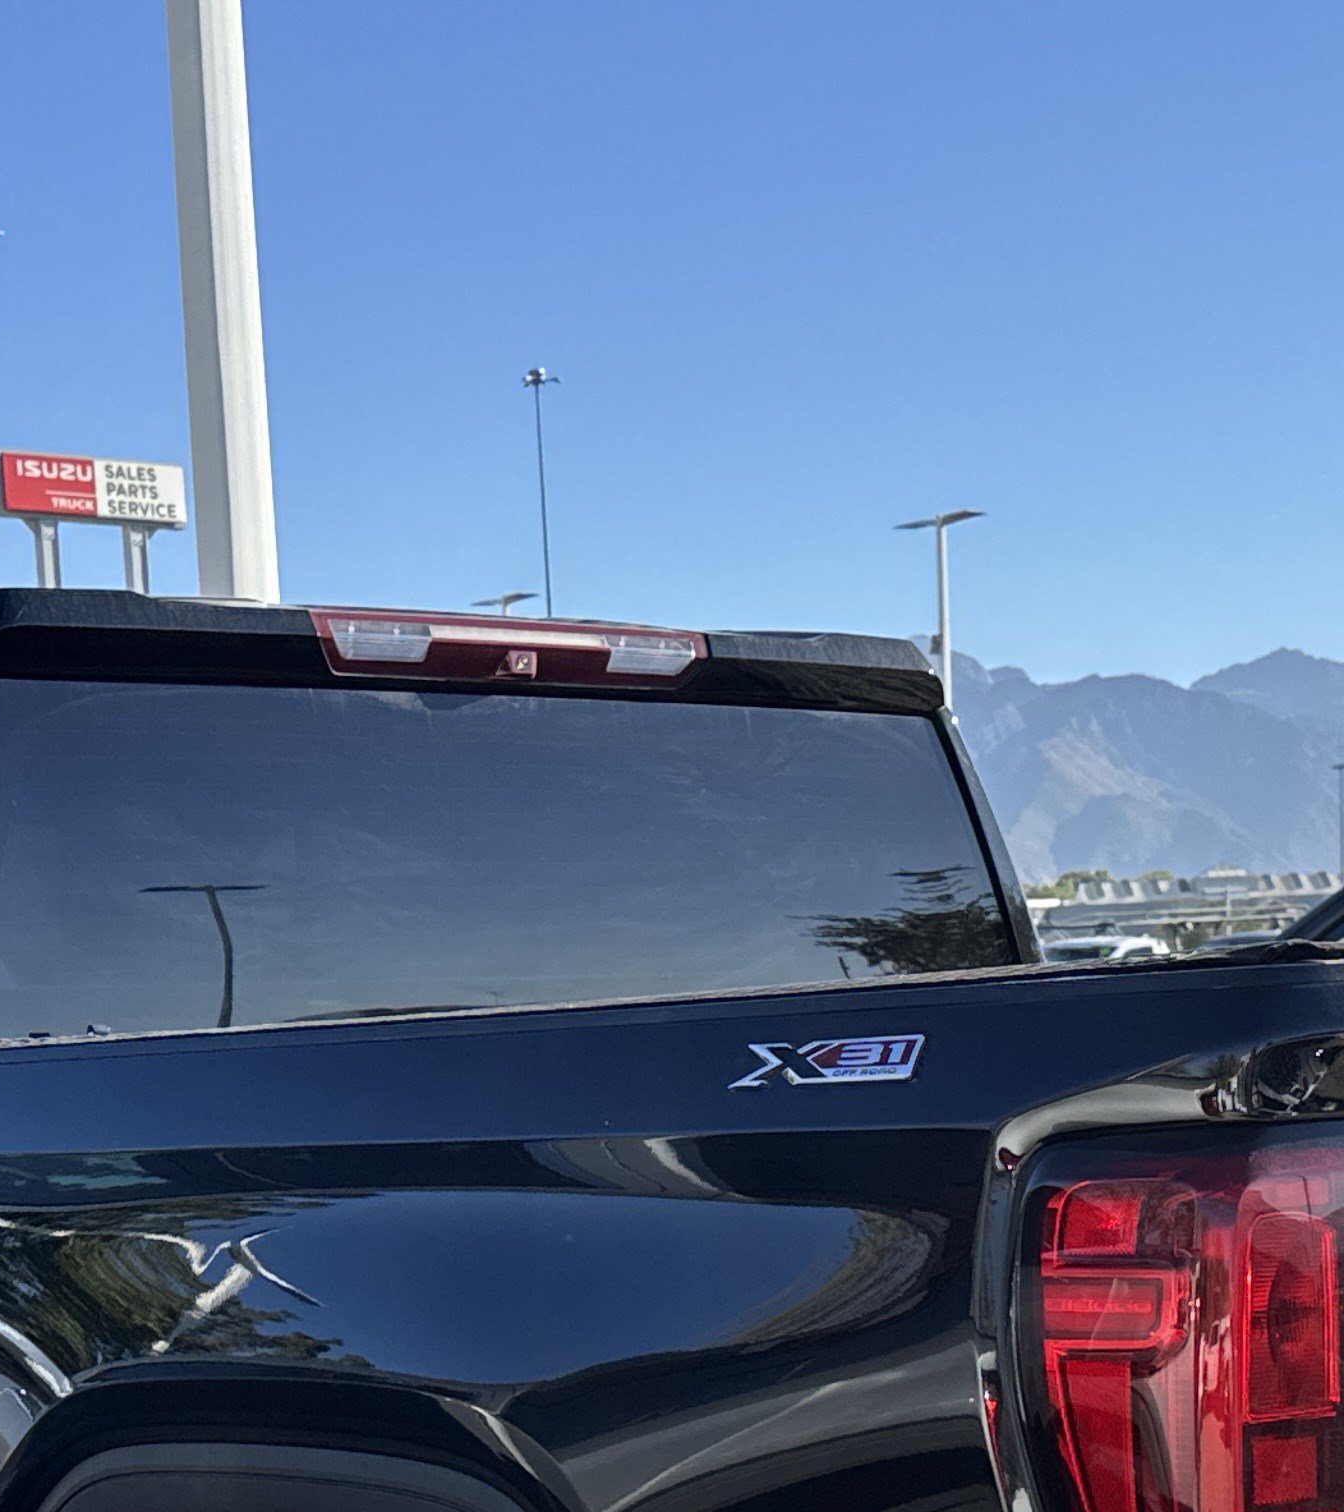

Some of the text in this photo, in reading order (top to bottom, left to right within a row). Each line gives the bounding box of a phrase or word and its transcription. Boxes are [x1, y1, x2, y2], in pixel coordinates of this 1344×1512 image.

[16, 458, 94, 482] ISUZU
[104, 463, 157, 481] SALES
[105, 482, 159, 500] PARTS
[51, 496, 95, 511] TRUCK
[107, 500, 177, 519] SERVICE
[727, 1034, 925, 1091] X31
